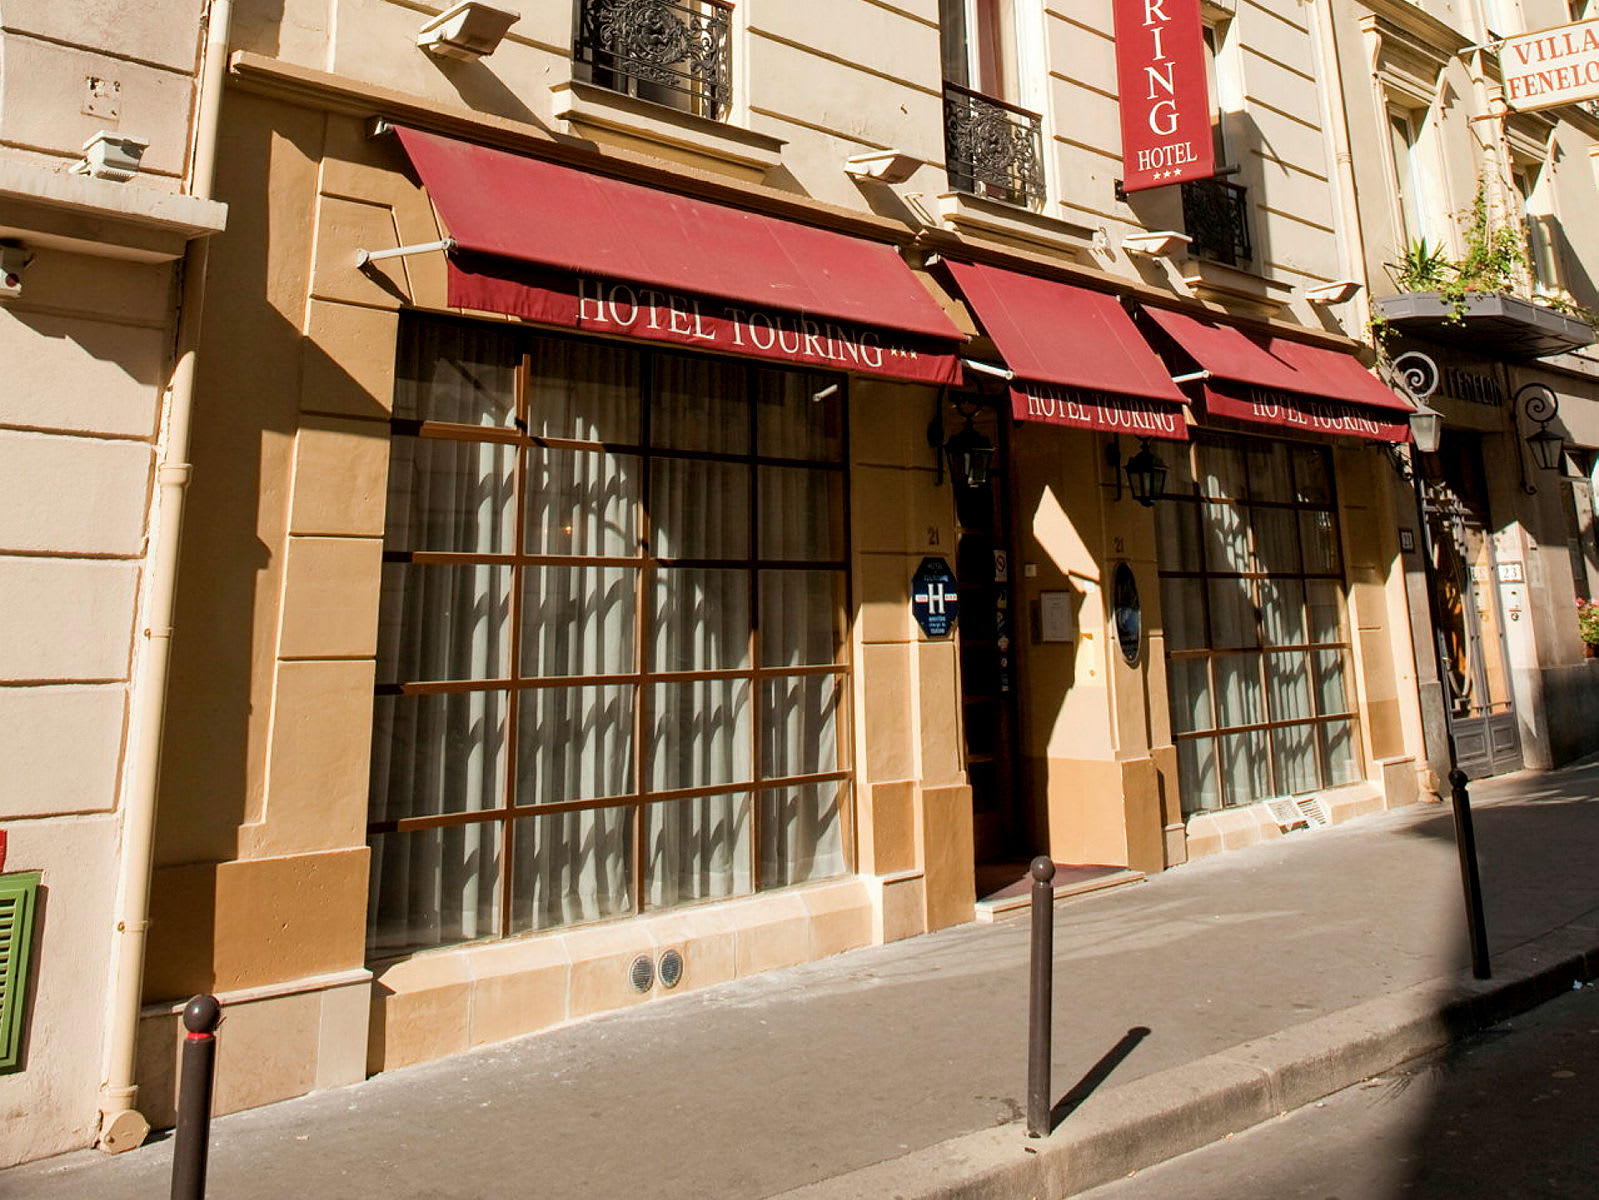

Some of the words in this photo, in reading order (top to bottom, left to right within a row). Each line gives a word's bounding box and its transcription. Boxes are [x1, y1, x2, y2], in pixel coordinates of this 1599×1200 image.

[1512, 28, 1599, 65] VILLA
[1137, 142, 1198, 171] HOTEL
[575, 278, 716, 340] HOTEL
[724, 304, 884, 368] TOURING
[1026, 384, 1091, 421] HOTEL
[1096, 393, 1175, 432] TOURING
[1251, 388, 1308, 425] HOTEL
[1310, 401, 1380, 435] TOURING
[928, 527, 940, 545] 21
[1503, 567, 1518, 579] 23
[927, 583, 946, 615] H
